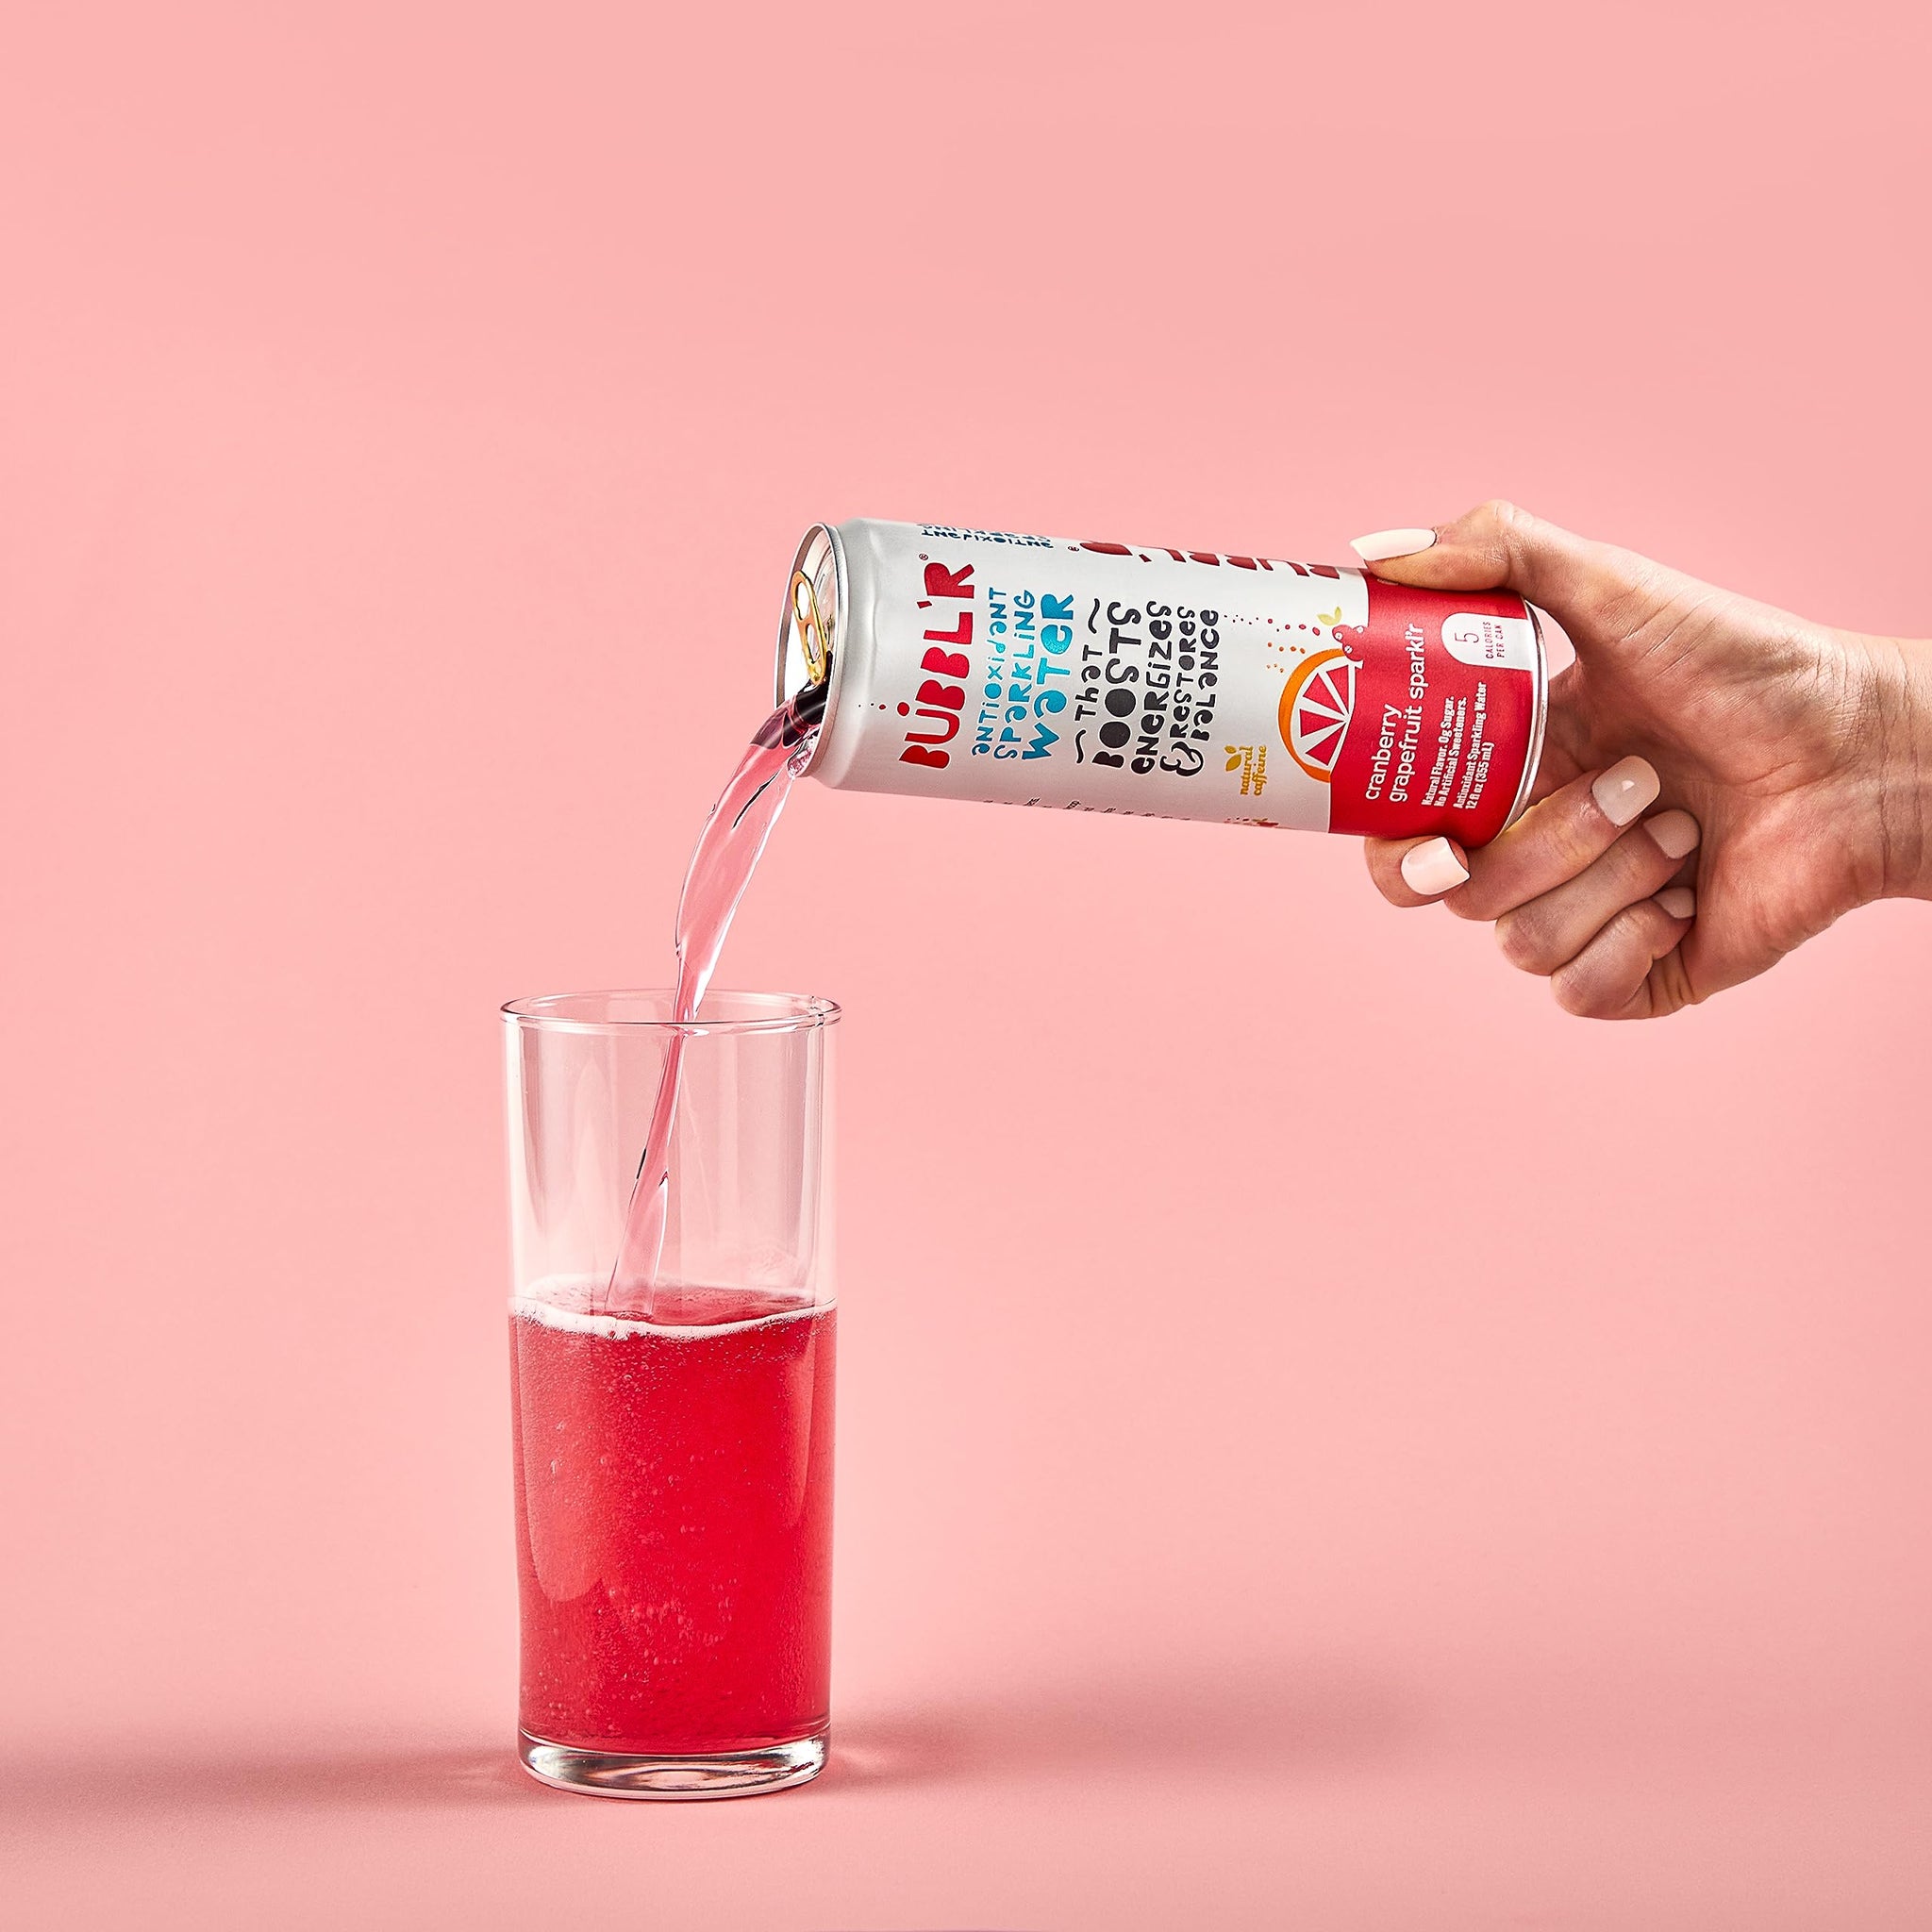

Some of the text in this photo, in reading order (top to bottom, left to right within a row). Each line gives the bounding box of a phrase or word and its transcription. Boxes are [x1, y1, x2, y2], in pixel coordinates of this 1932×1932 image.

[1454, 632, 1480, 643] 5
[1483, 621, 1494, 659] CALORIES
[1494, 625, 1506, 658] PER CAN
[1091, 602, 1141, 769] BOOSTS
[1389, 623, 1429, 803] grapefruit sparkl'r
[1365, 704, 1402, 800] cranberry
[1422, 776, 1439, 806] Natural
[1431, 745, 1448, 775] Flavor.
[1441, 696, 1455, 729] Sugar.
[1434, 697, 1467, 807] No Artificial Sweeteners.
[1453, 681, 1488, 808] Antioxidant Sparkling Water
[1240, 745, 1254, 795] natural
[1252, 745, 1267, 796] caffeine
[1473, 783, 1482, 793] oz
[1475, 761, 1490, 783] (355
[1465, 800, 1477, 809] 12
